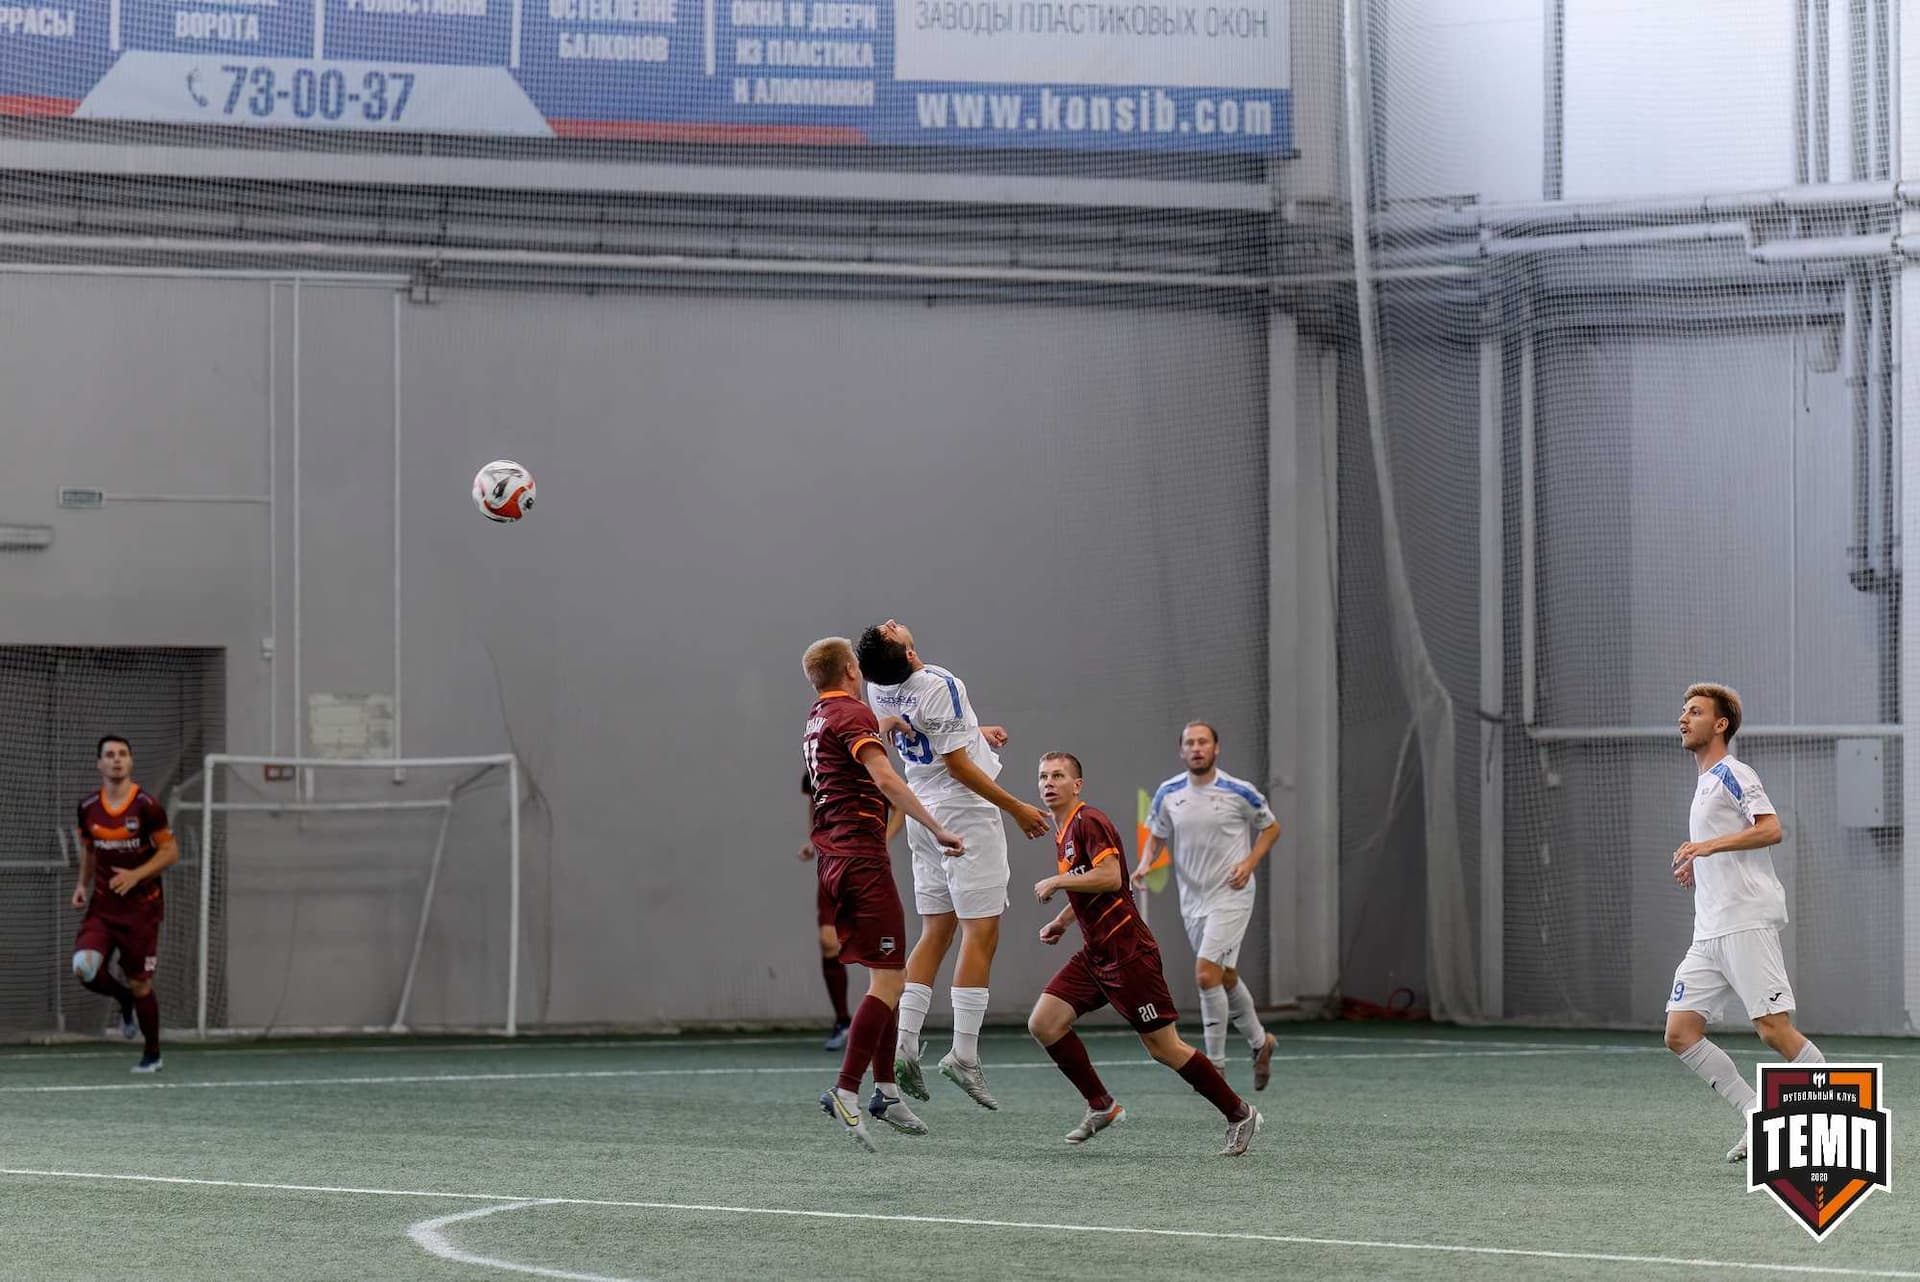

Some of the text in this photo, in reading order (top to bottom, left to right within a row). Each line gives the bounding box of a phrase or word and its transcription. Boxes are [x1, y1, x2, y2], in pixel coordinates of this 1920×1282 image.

[176, 10, 260, 41] ВОРОТА
[915, 1, 1268, 38] ЗАВОДЫ ПЛАСТИКОВЫХ ОКОН
[559, 32, 669, 62] БАЛКОНОВ
[735, 38, 874, 68] ИЗ ПЛАСТИКА
[221, 64, 415, 121] 73-00-37
[755, 77, 874, 107] АЛЮМИНИЯ
[916, 87, 1272, 135] www.konsib.com
[1138, 1002, 1159, 1023] 20
